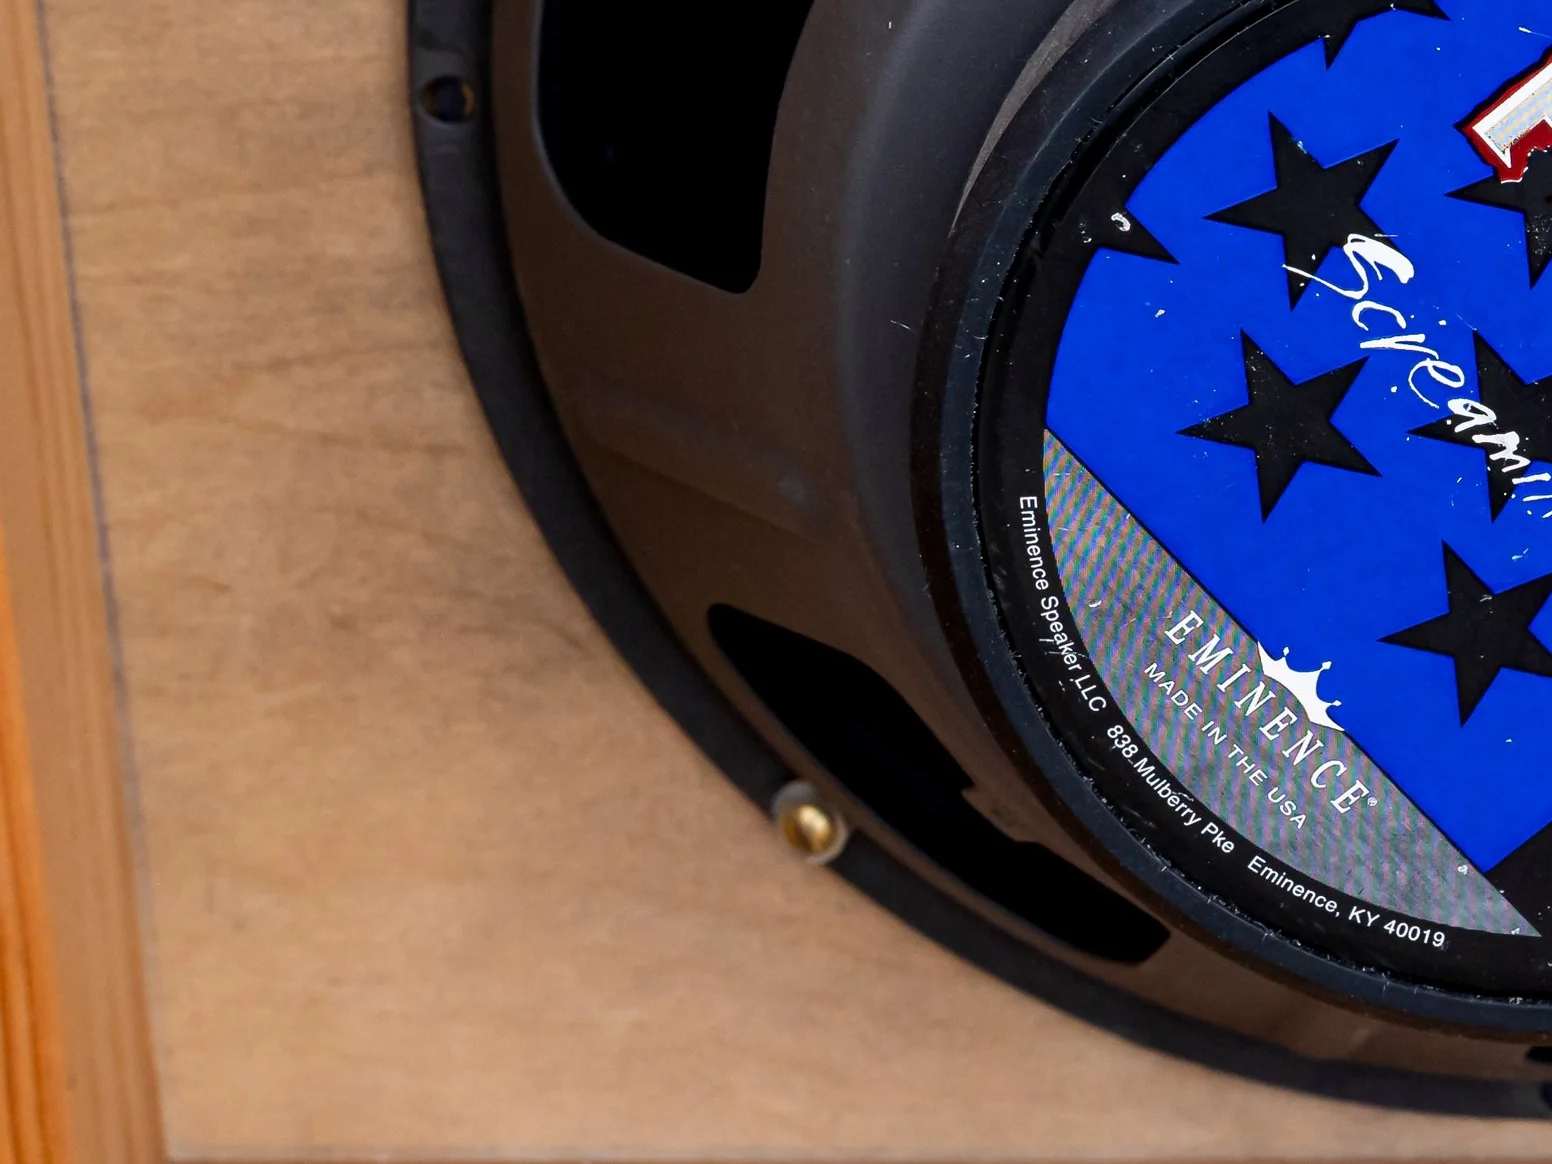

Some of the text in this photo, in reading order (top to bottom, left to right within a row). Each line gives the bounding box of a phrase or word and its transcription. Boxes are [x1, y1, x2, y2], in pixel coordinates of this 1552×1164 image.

[1019, 496, 1049, 591] Eminence
[1074, 675, 1107, 712] LLC
[1107, 724, 1139, 758] 838
[1133, 757, 1202, 827] Mulberry
[1200, 822, 1235, 853] Pke
[1247, 855, 1341, 918] Eminence,
[1348, 906, 1380, 928] KY
[1383, 919, 1446, 947] 40019
[1144, 662, 1307, 829] MADE IN THE USA
